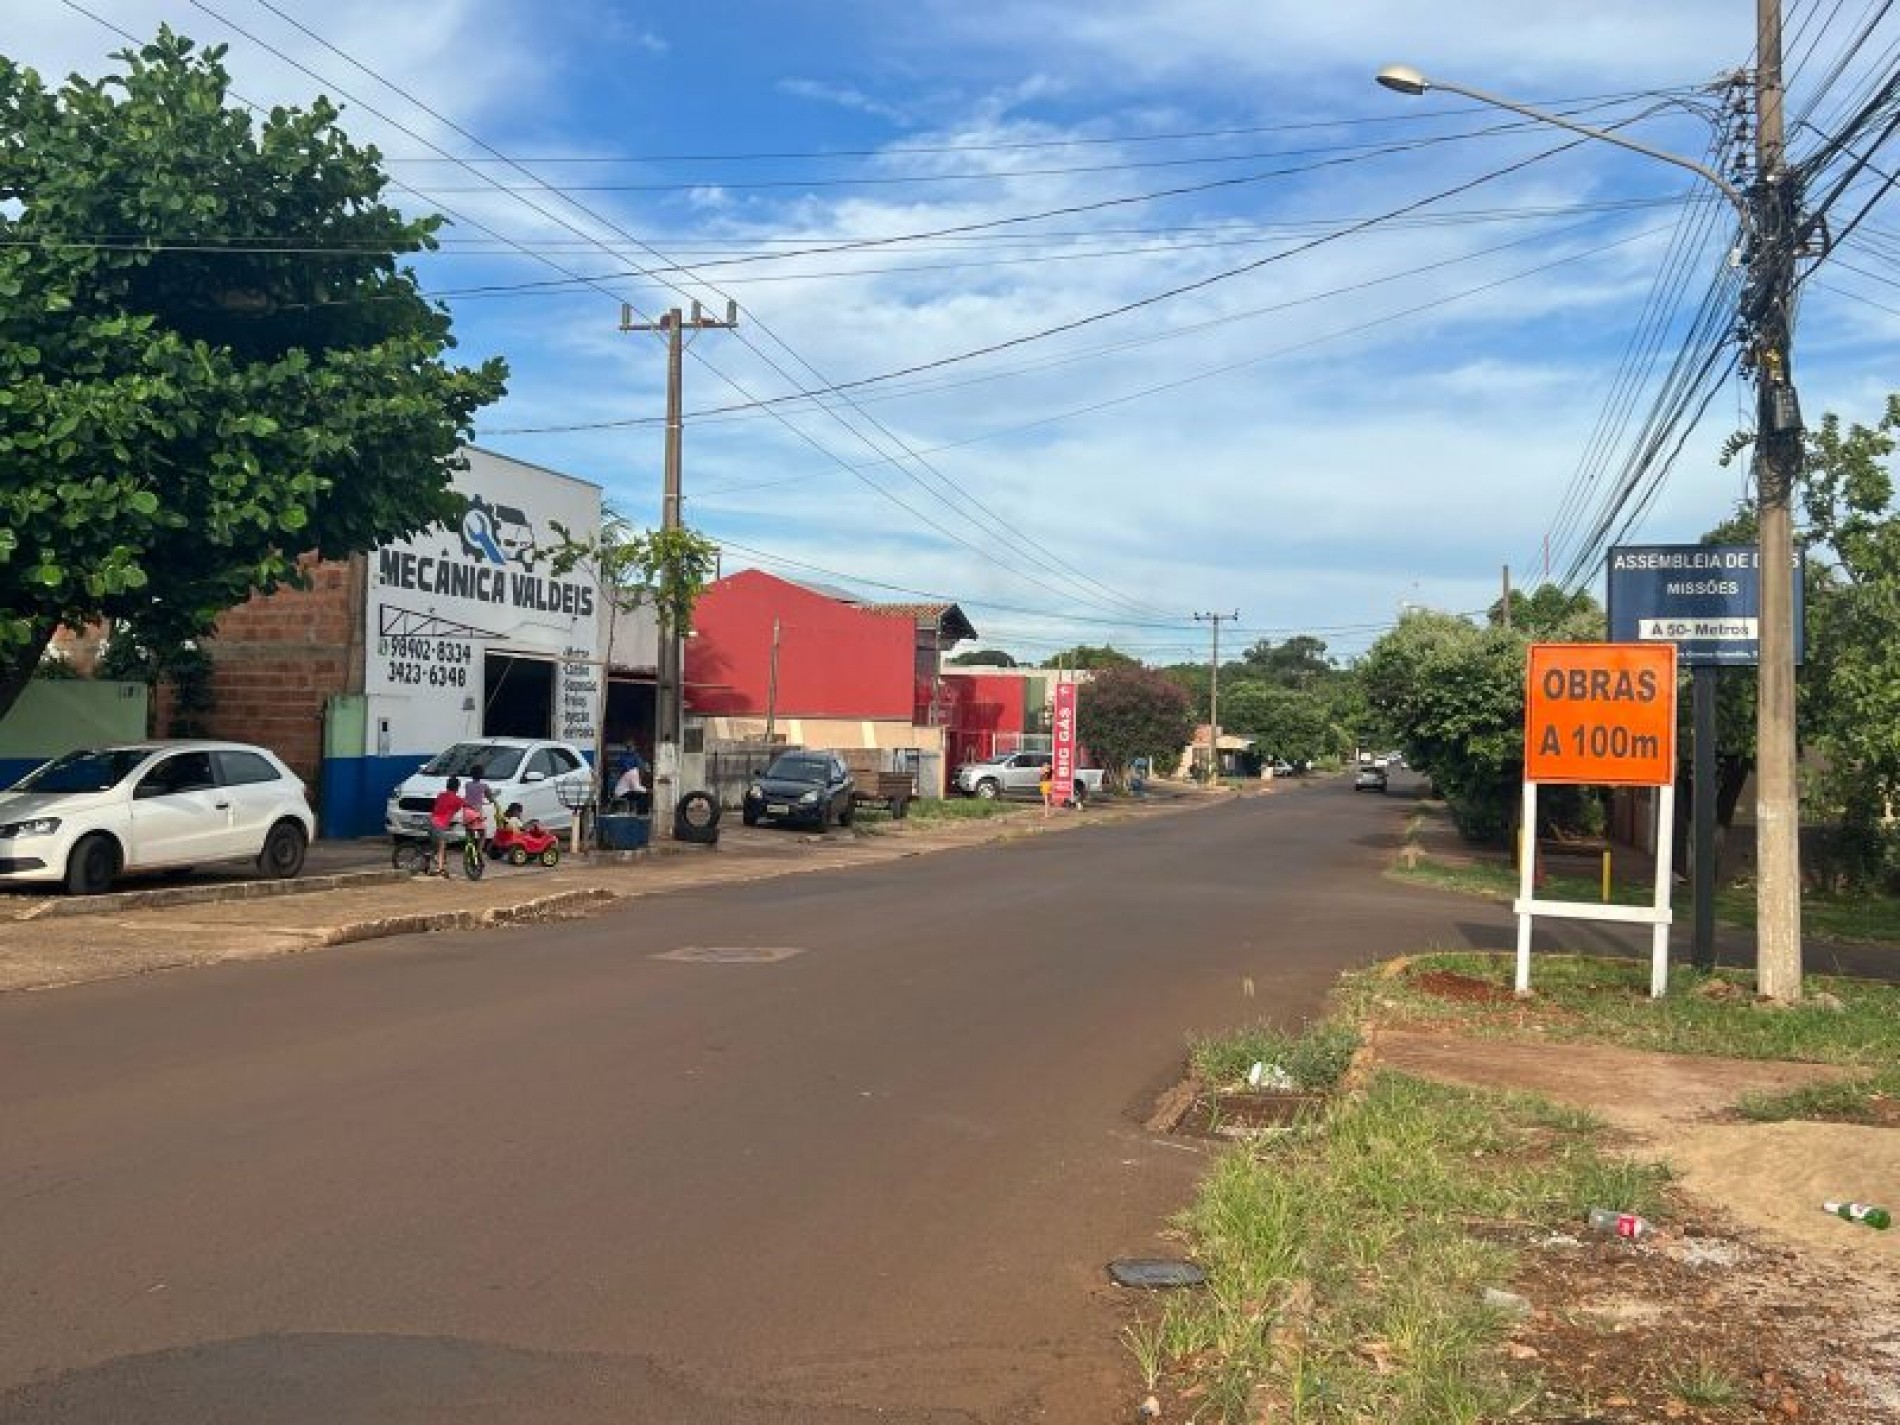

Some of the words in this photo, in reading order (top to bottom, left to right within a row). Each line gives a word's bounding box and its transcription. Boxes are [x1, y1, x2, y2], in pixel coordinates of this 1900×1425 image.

[1614, 552, 1722, 570] ASSEMBLEIA
[1726, 553, 1749, 569] DE
[512, 572, 594, 616] VALDEIS
[1666, 580, 1739, 595] MISSÕES
[1695, 622, 1749, 636] Metros
[387, 660, 466, 687] 3423-6348
[1543, 669, 1657, 702] OBRAS
[1539, 723, 1561, 756] A
[1571, 724, 1659, 759] 100m
[1058, 747, 1070, 777] BIG
